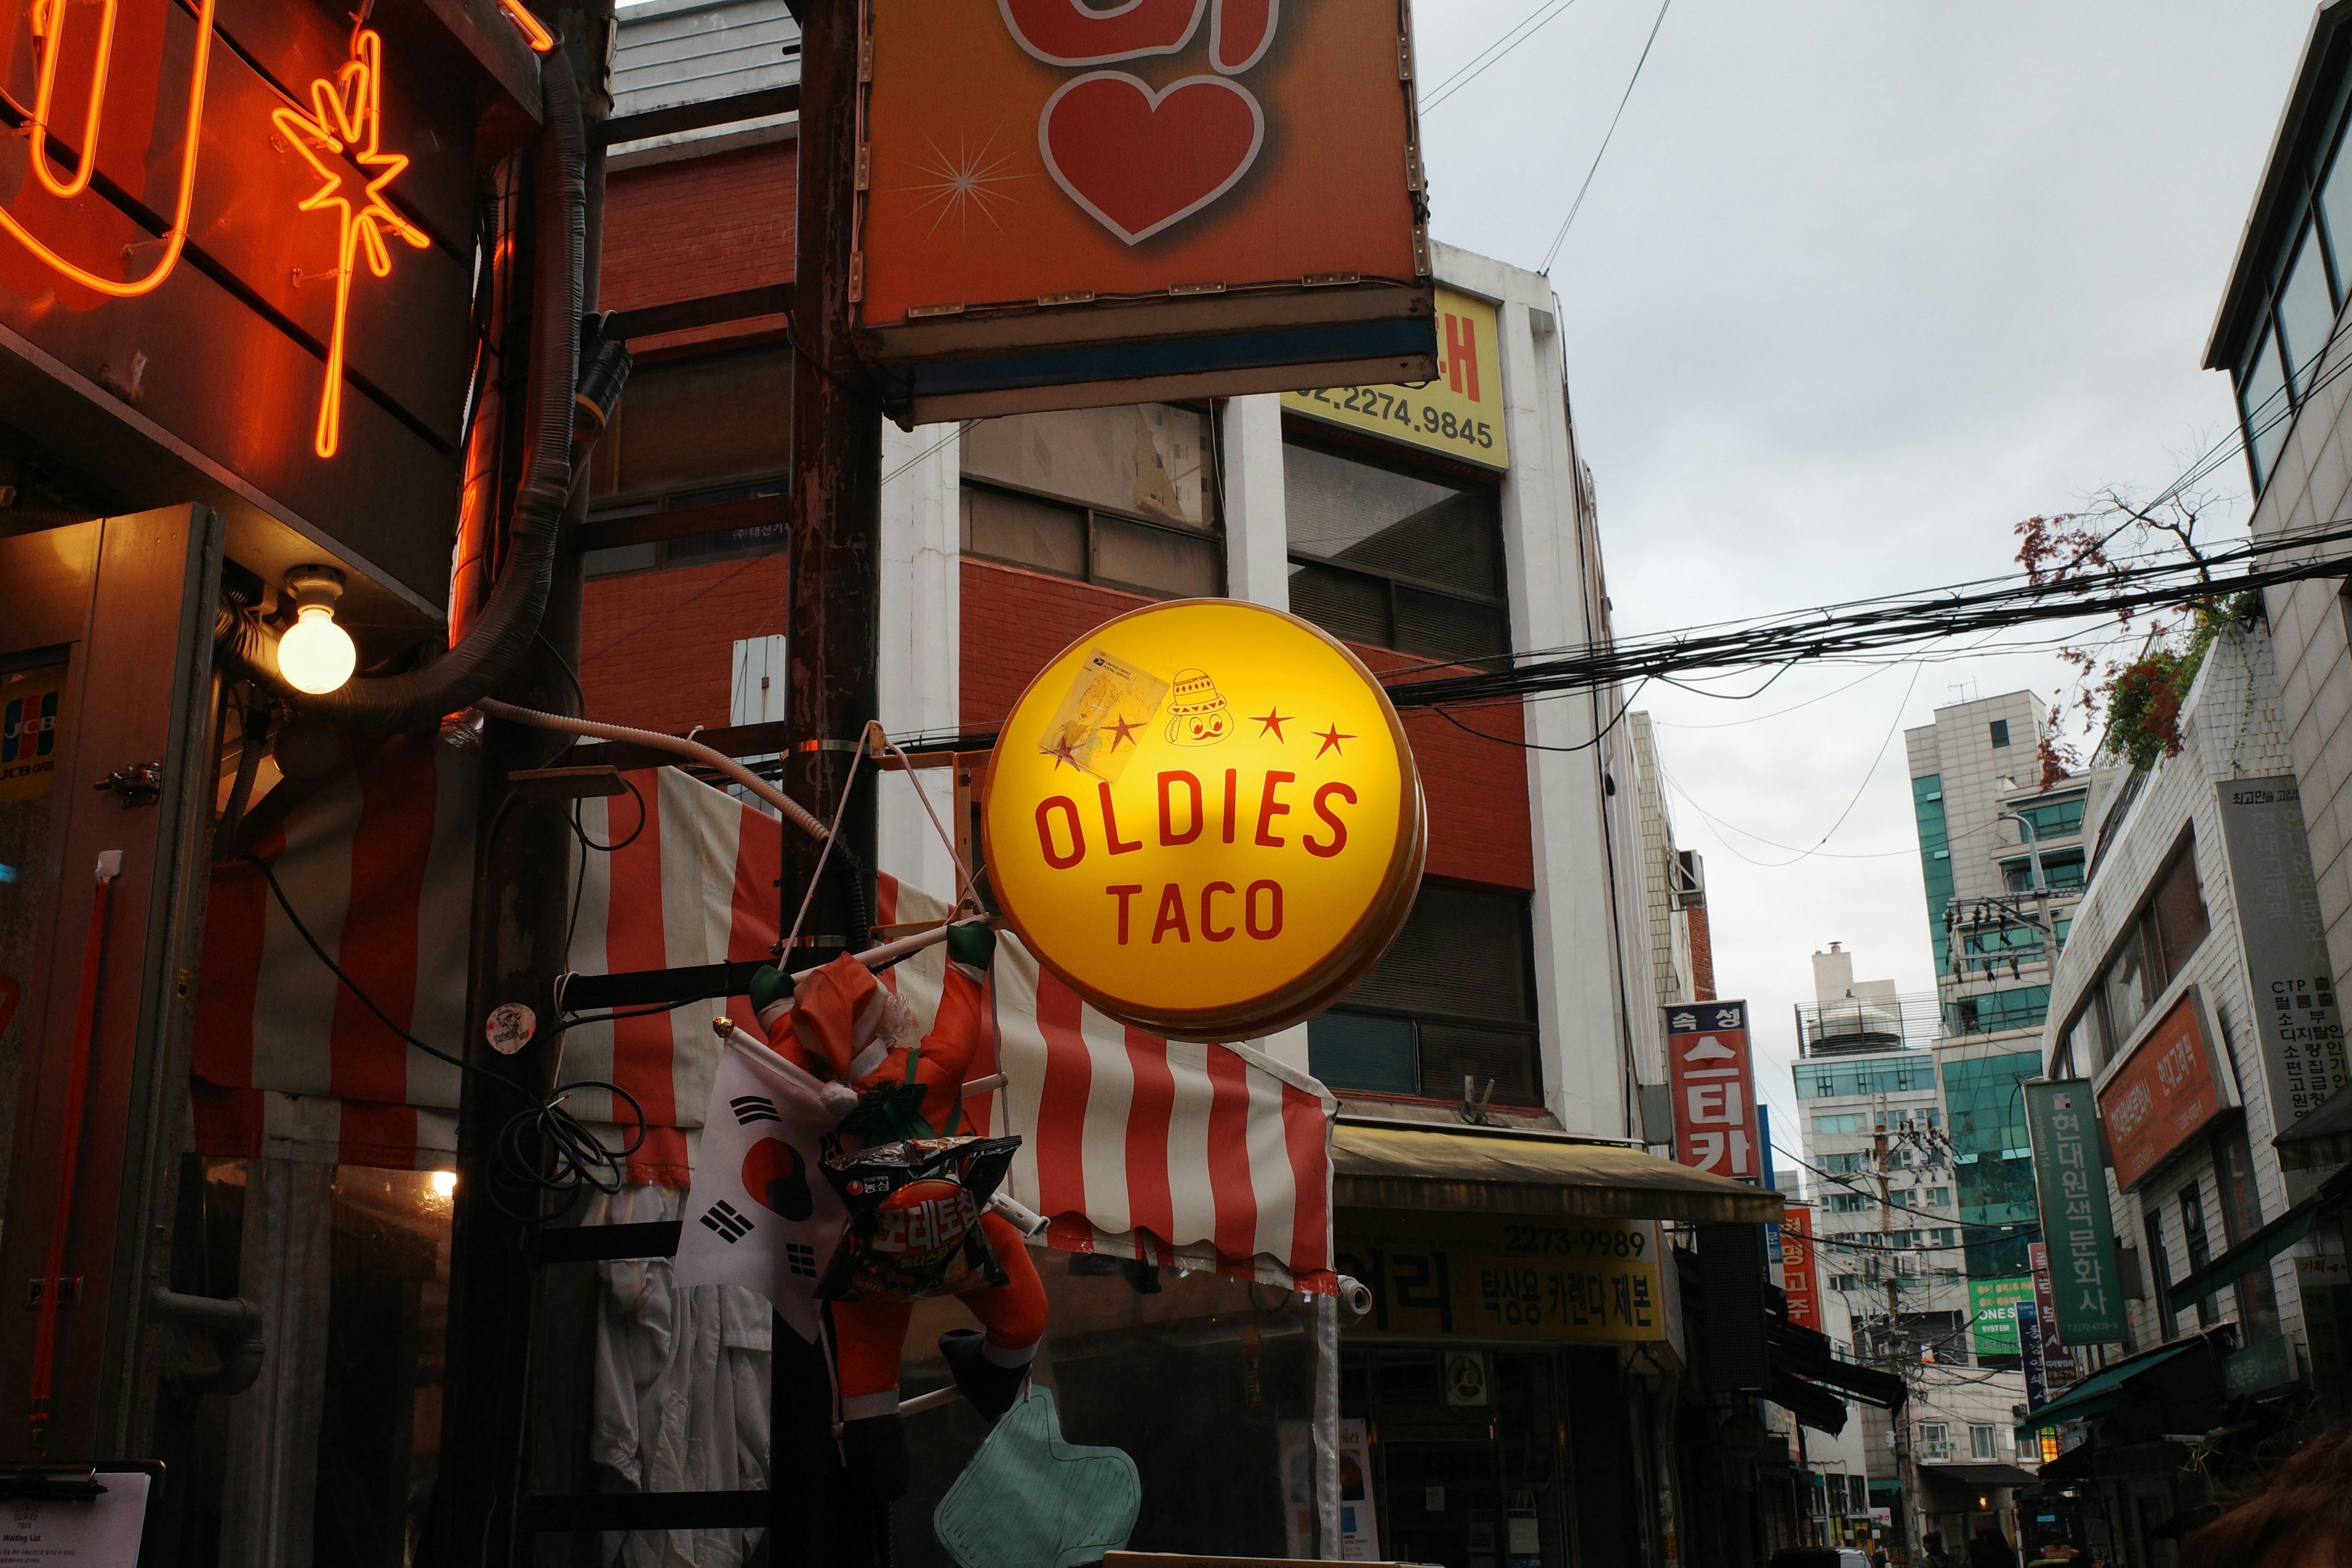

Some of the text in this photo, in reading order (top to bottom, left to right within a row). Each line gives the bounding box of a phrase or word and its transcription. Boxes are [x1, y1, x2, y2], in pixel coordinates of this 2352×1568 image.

[1434, 313, 1480, 402] H
[1296, 387, 1493, 448] 2.2274.9845
[1102, 665, 1116, 674] POSTAL
[1105, 662, 1131, 676] UNITED STATES
[5, 715, 56, 738] JCB
[0, 760, 54, 781] JCB CARDS
[2232, 790, 2274, 805] 최고만을
[1034, 768, 1358, 870] OLDIES
[1105, 879, 1284, 946] TACO
[2272, 980, 2305, 993] CTP
[2157, 1032, 2198, 1097] 현대그래픽
[1683, 1036, 1750, 1174] 스티카
[2111, 1077, 2153, 1143] 현대원색문화사
[864, 1180, 889, 1194] 농심
[872, 1191, 979, 1252] 포테토칩
[2052, 1113, 2107, 1315] 현대원색문화사
[1505, 1225, 1645, 1257] 2273-9989
[31, 1282, 74, 1303] PH
[856, 1280, 882, 1294] OLDIES
[1481, 1268, 1652, 1327] 탁상용 카렌다 제본
[1979, 1308, 2006, 1321] ONE
[15, 1513, 38, 1521] OLDIES
[3, 1534, 27, 1543] Waiting
